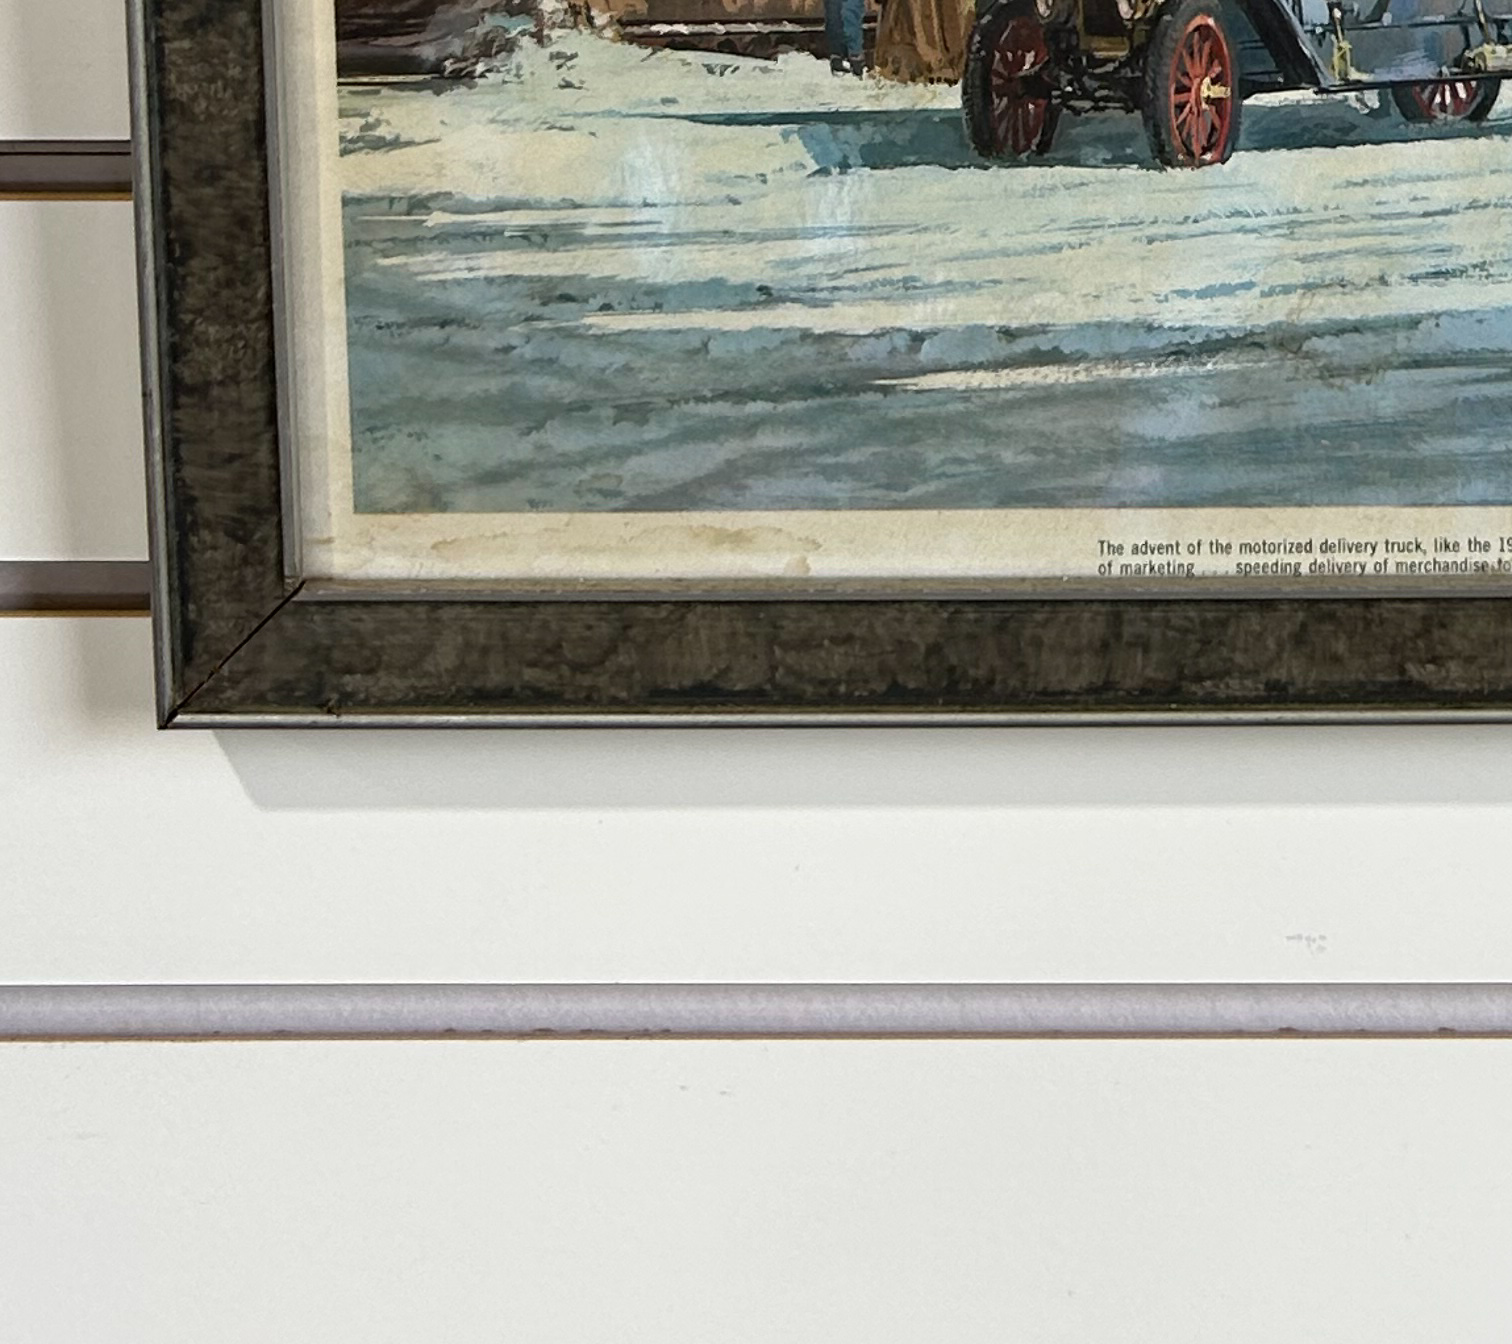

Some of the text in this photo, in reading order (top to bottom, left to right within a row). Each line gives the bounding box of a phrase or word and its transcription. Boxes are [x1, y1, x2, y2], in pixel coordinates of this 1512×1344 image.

[1098, 539, 1124, 555] The
[1131, 539, 1180, 555] advent
[1187, 539, 1202, 555] of
[1209, 539, 1232, 555] the
[1239, 539, 1312, 555] motorized
[1319, 538, 1378, 557] delivery
[1434, 538, 1460, 554] like
[1468, 538, 1491, 554] the
[1098, 560, 1112, 575] of
[1119, 560, 1195, 576] marketing
[1235, 559, 1302, 576] speeding
[1308, 559, 1367, 575] delivery
[1373, 559, 1388, 574] of
[1395, 558, 1489, 573] merchandise
